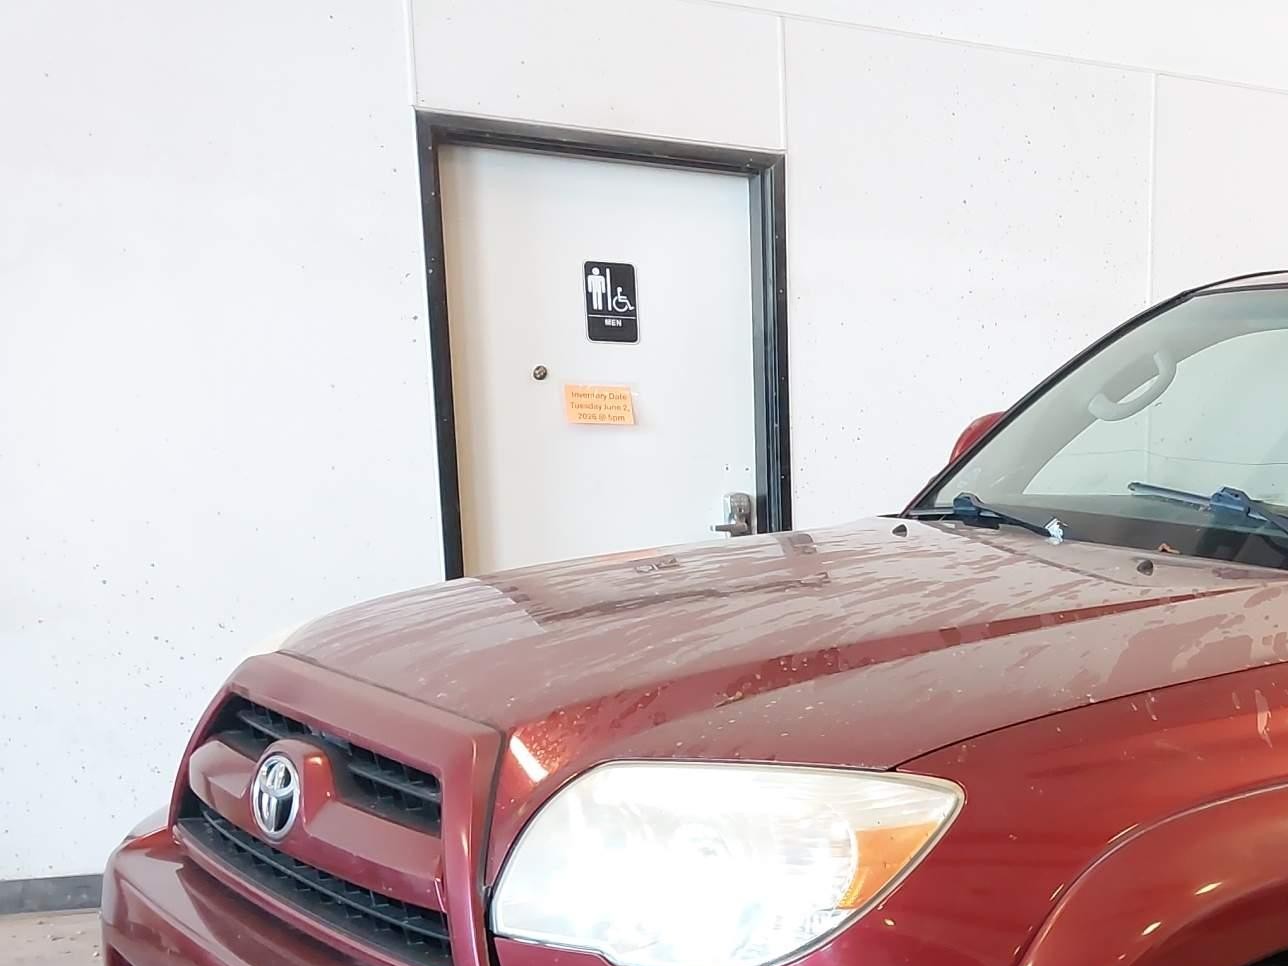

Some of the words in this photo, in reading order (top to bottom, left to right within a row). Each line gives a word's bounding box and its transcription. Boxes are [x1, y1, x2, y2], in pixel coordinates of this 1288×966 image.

[604, 318, 622, 327] MEN
[571, 391, 607, 401] Inventory
[608, 392, 627, 400] Date
[571, 401, 602, 411] Tuesday
